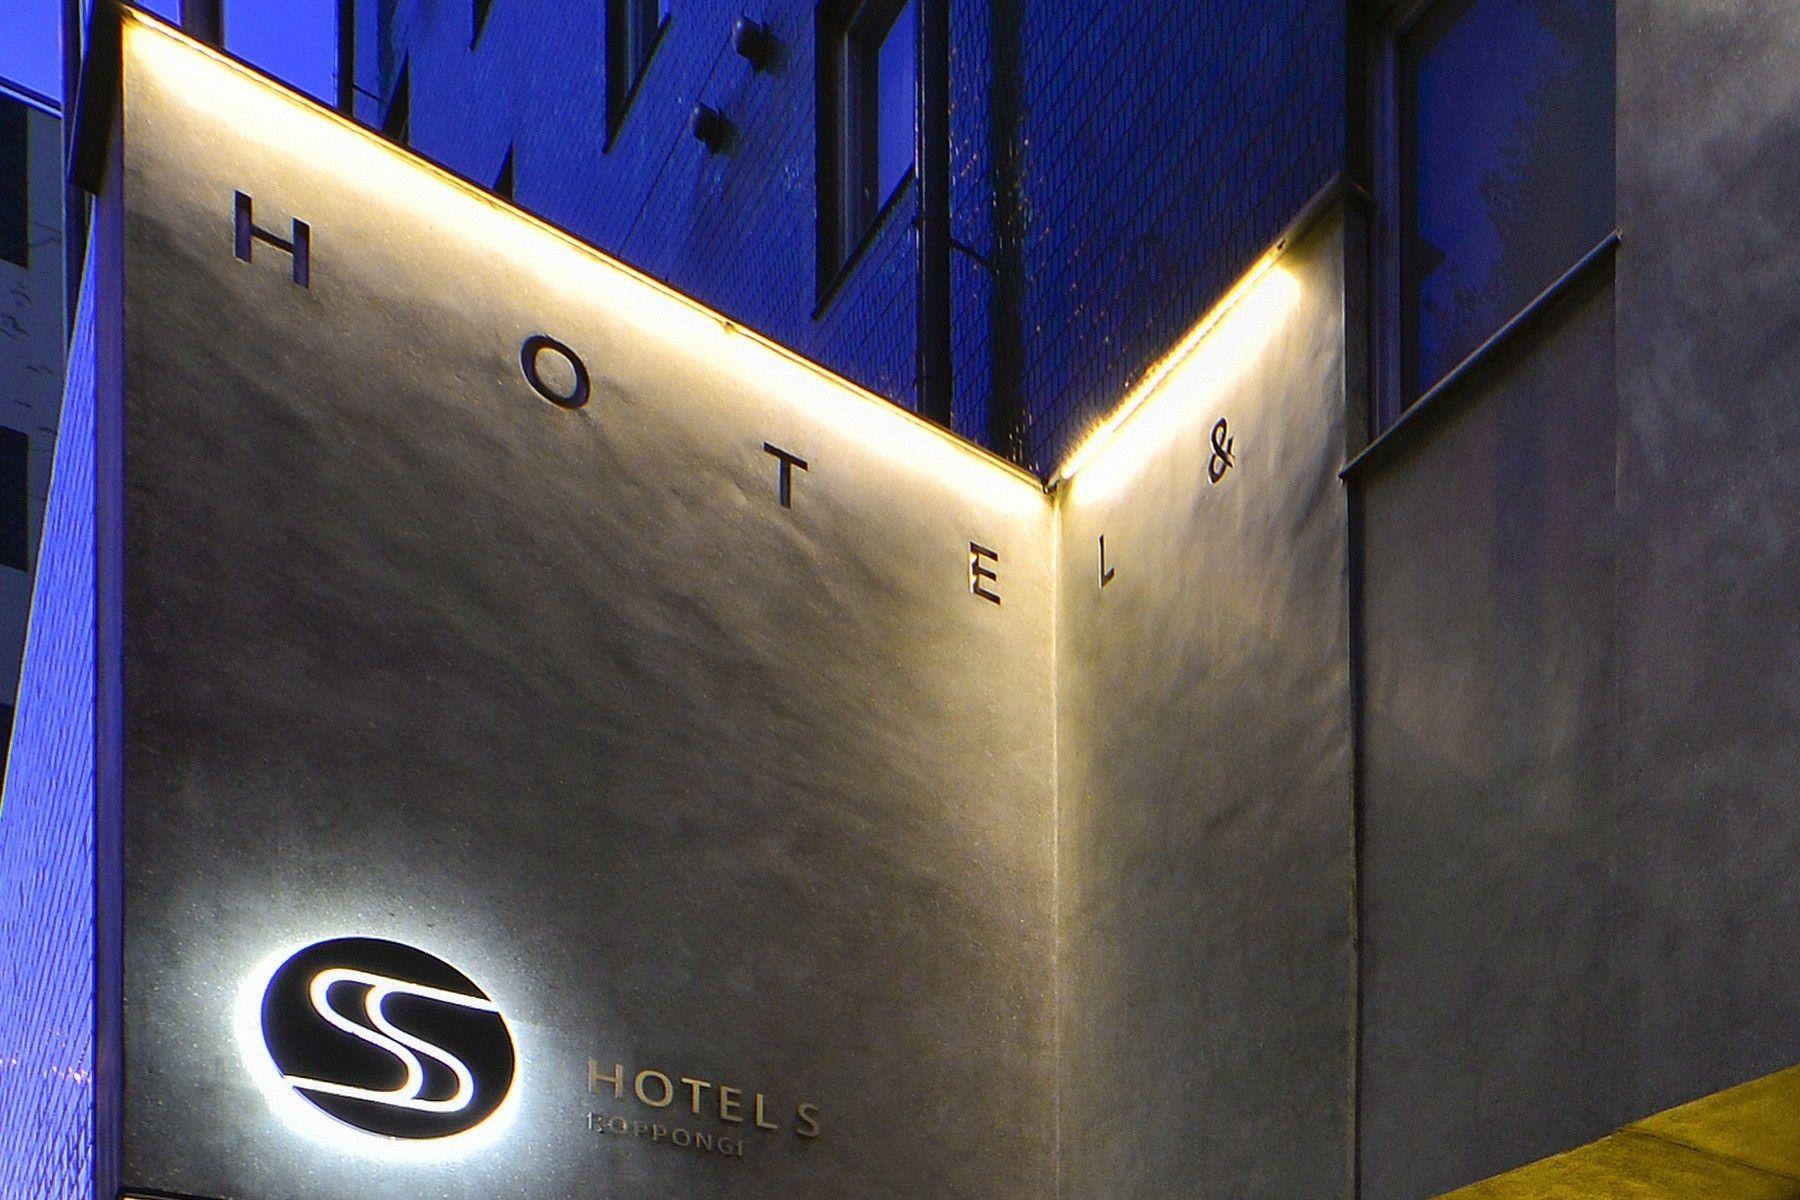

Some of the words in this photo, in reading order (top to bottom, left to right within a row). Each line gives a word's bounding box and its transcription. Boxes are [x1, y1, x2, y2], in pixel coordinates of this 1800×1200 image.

[1207, 416, 1236, 485] &
[587, 1056, 779, 1131] HOTEL
[586, 1111, 743, 1157] ROPPONGI
